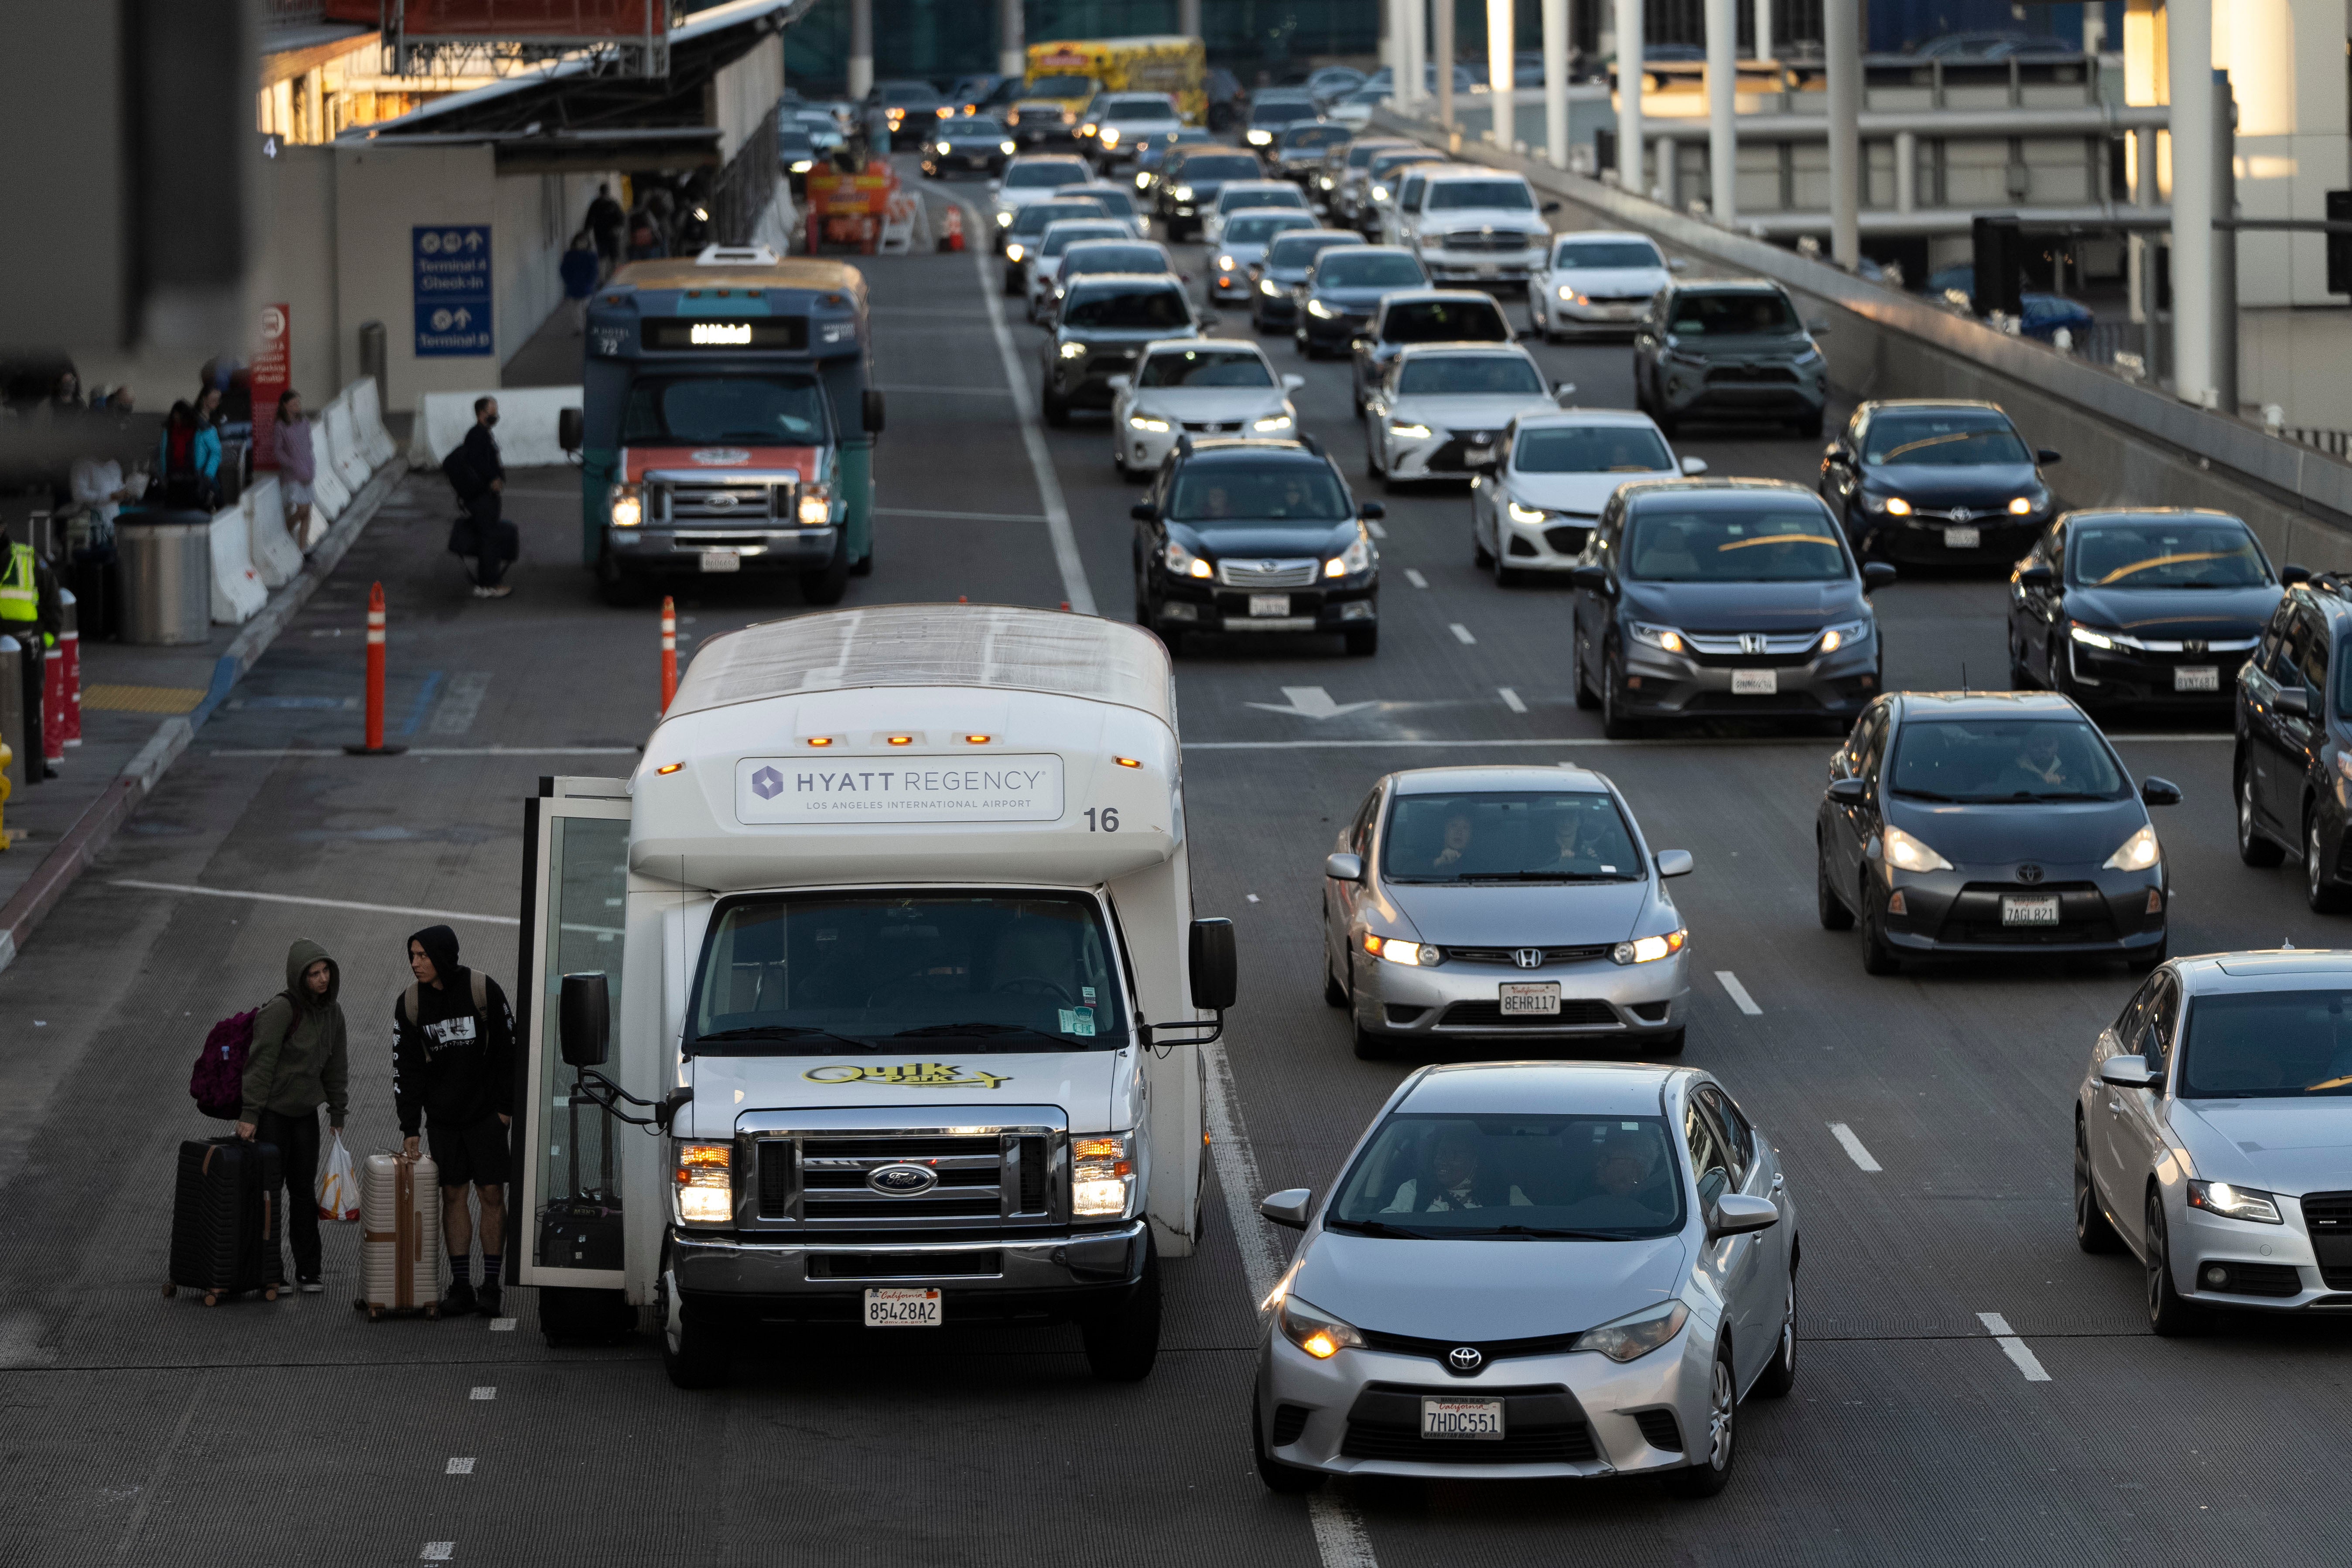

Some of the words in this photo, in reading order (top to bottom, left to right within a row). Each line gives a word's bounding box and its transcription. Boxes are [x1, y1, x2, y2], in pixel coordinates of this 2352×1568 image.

[263, 137, 277, 158] 4
[797, 772, 895, 792] HYATT
[807, 801, 827, 810] LOS
[832, 800, 883, 810] ANGELES
[888, 799, 978, 809] INTERNATIONAL
[983, 799, 1032, 808] AIRPORT
[1084, 807, 1119, 832] 16
[1504, 995, 1556, 1010] 8EHR117
[802, 1063, 959, 1083] Quik
[886, 1172, 917, 1185] Ford
[881, 1291, 927, 1302] California
[870, 1302, 936, 1320] 85428A2
[1439, 1403, 1489, 1413] California
[1428, 1413, 1498, 1433] 7HDC551
